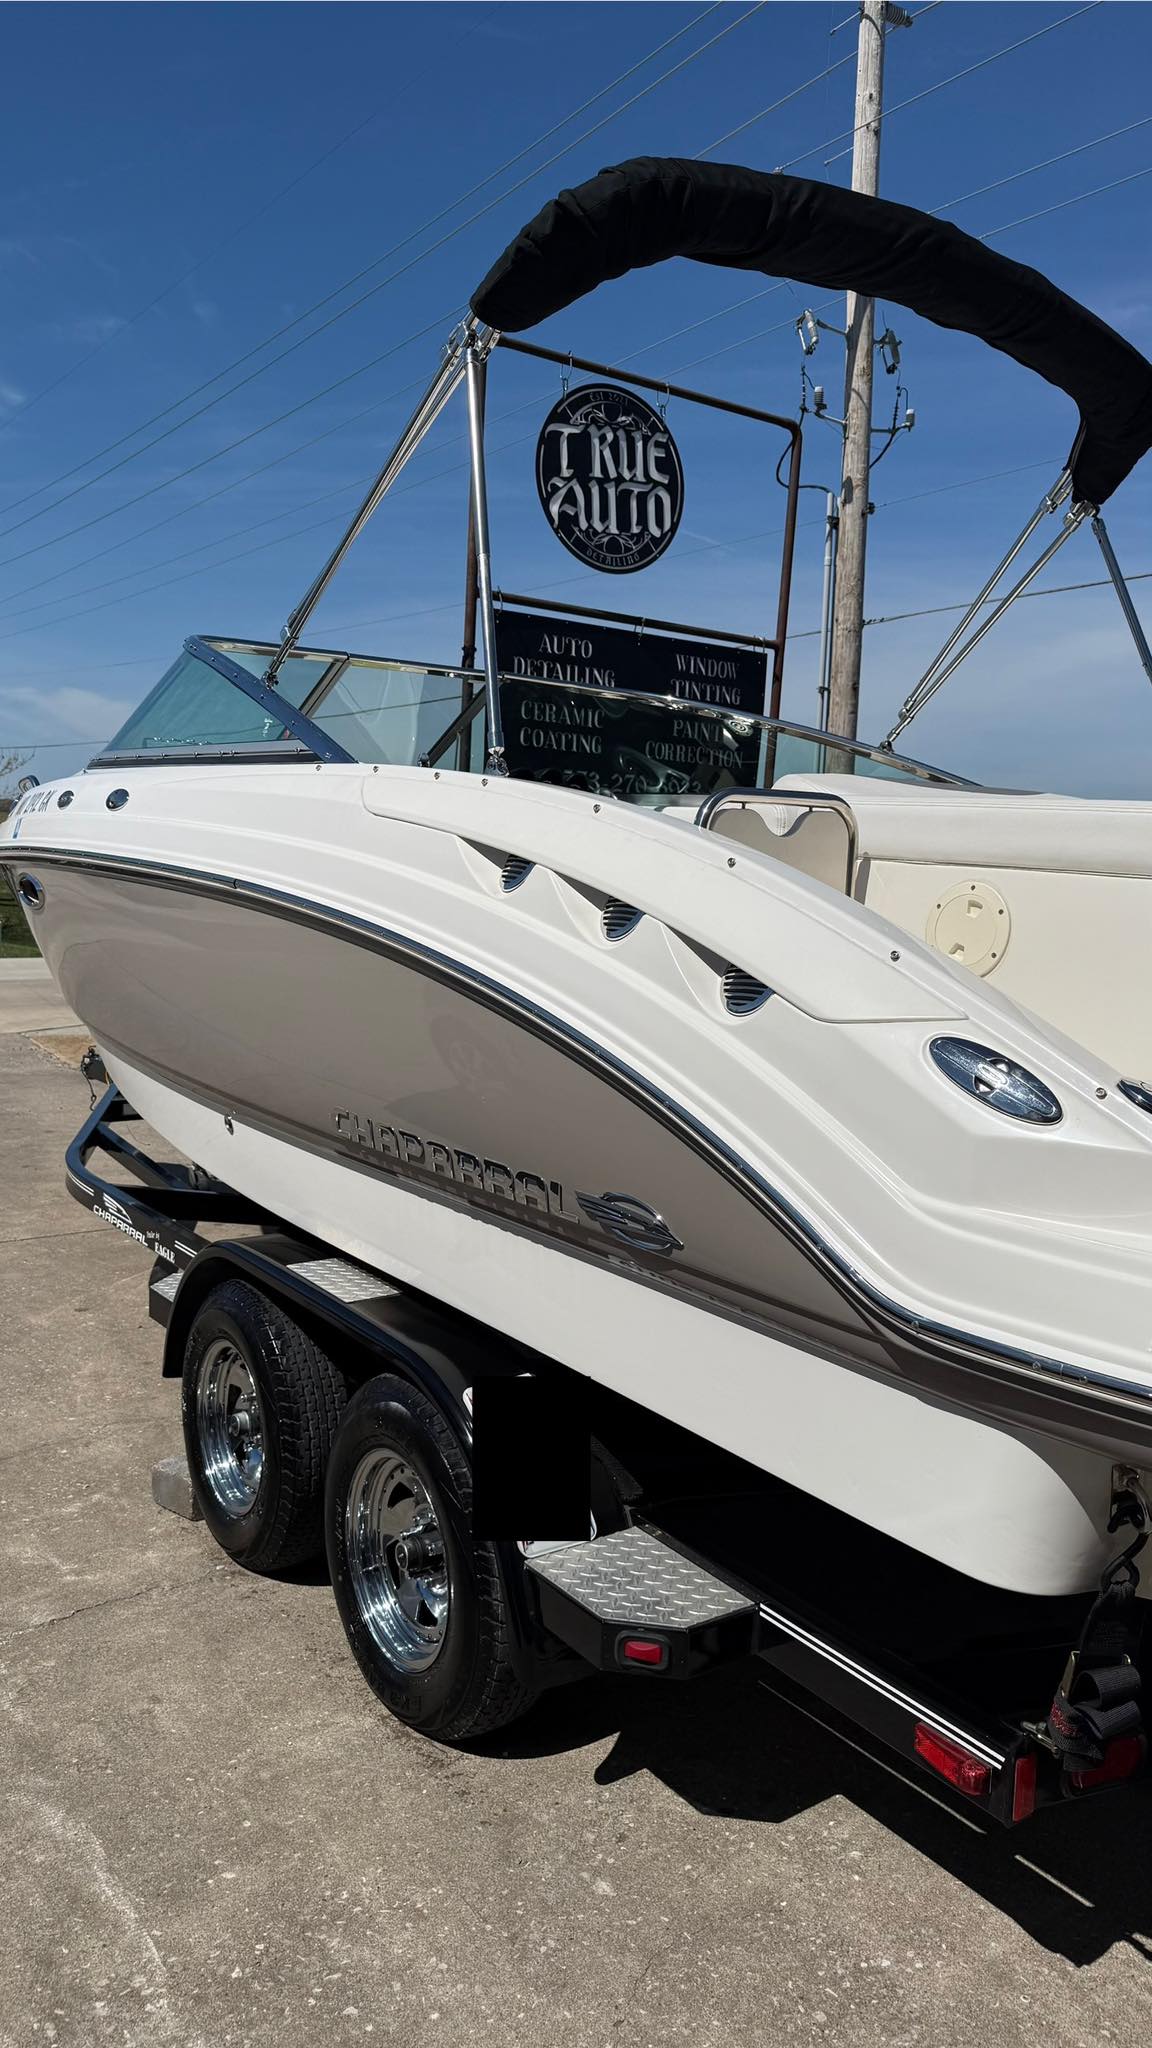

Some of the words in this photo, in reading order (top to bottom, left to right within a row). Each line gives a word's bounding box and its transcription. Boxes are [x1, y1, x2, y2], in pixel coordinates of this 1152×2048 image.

[545, 424, 669, 484] TRUE
[548, 479, 671, 538] AUTO
[539, 634, 593, 659] AUTO
[514, 657, 615, 687] DETAILING
[676, 654, 739, 680] WINDOW
[671, 680, 741, 706] TINTING
[521, 701, 605, 729] CERAMIC
[520, 727, 602, 754] COATING
[673, 720, 721, 744] PAINT
[645, 741, 744, 769] CORRECTION
[332, 1107, 580, 1224] CHAPARRAL
[93, 1206, 148, 1247] CHAPARRAL
[154, 1242, 176, 1264] EAGLE
